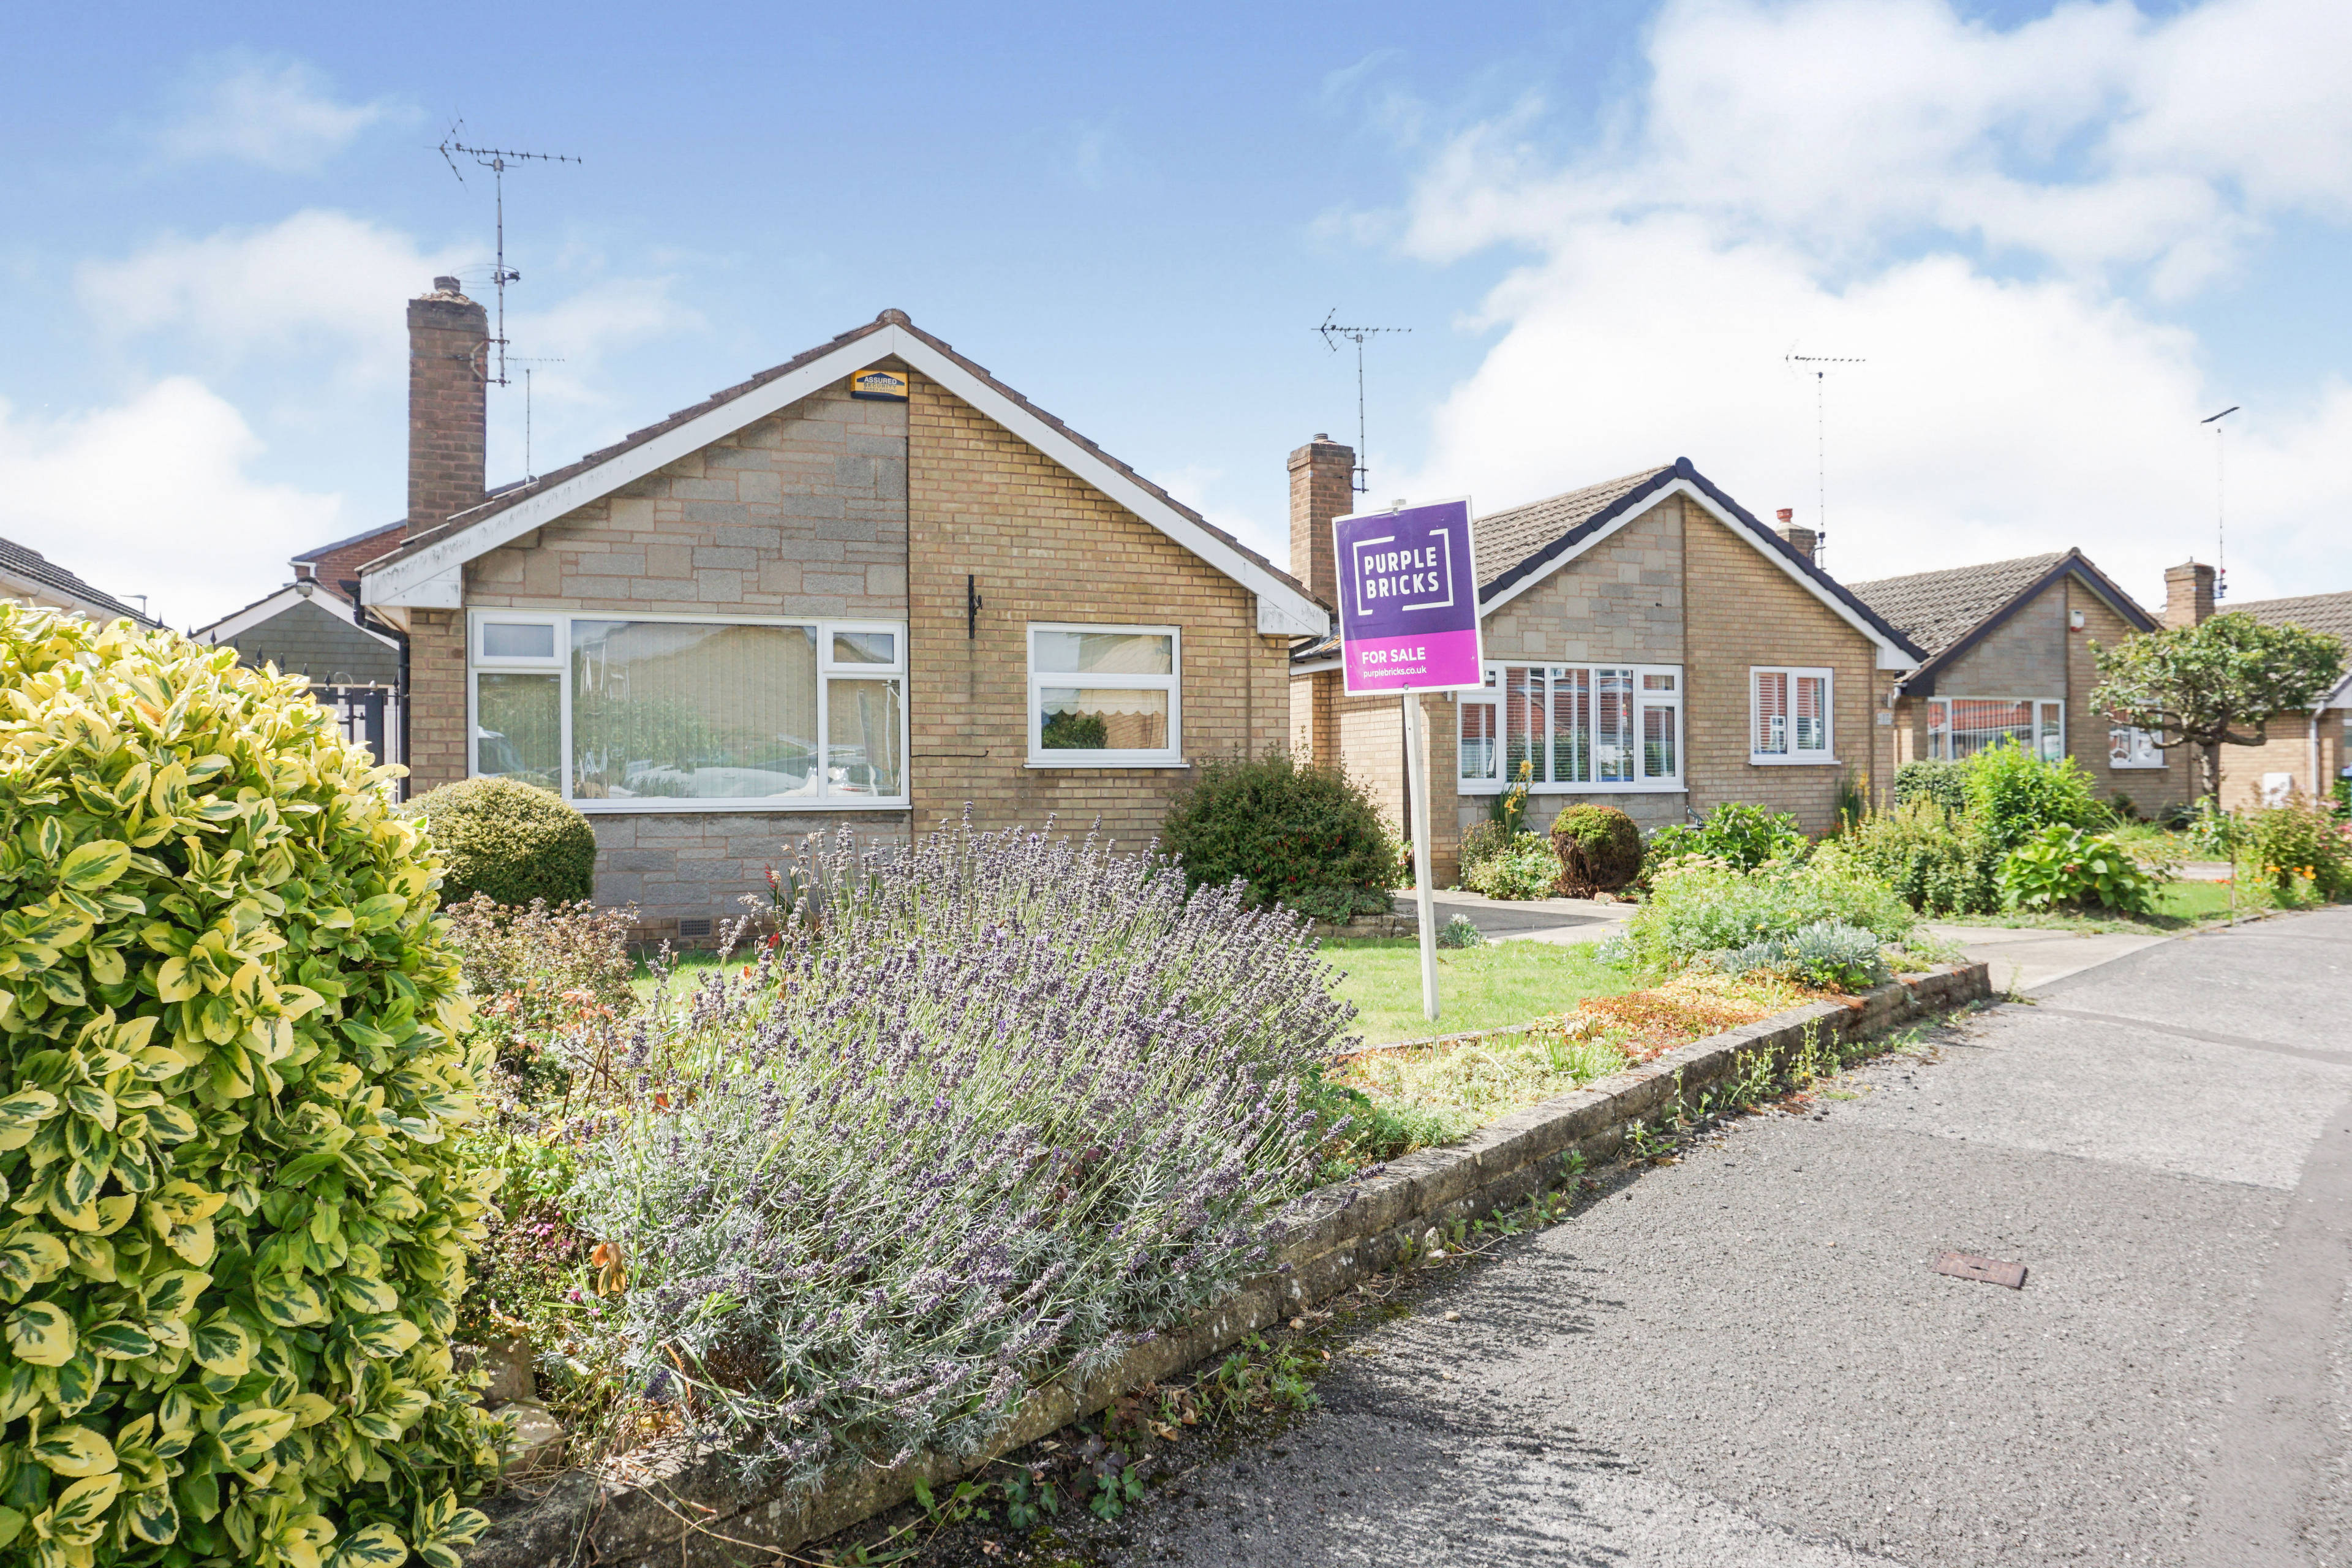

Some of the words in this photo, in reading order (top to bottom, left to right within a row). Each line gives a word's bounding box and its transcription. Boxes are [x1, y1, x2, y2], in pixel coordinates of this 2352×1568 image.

[1364, 546, 1437, 575] PURPLE
[1366, 571, 1439, 599] BRICKS
[1362, 649, 1387, 664] FOR
[1390, 647, 1426, 662] SALE
[1363, 665, 1427, 679] purplebricks.co.uk
